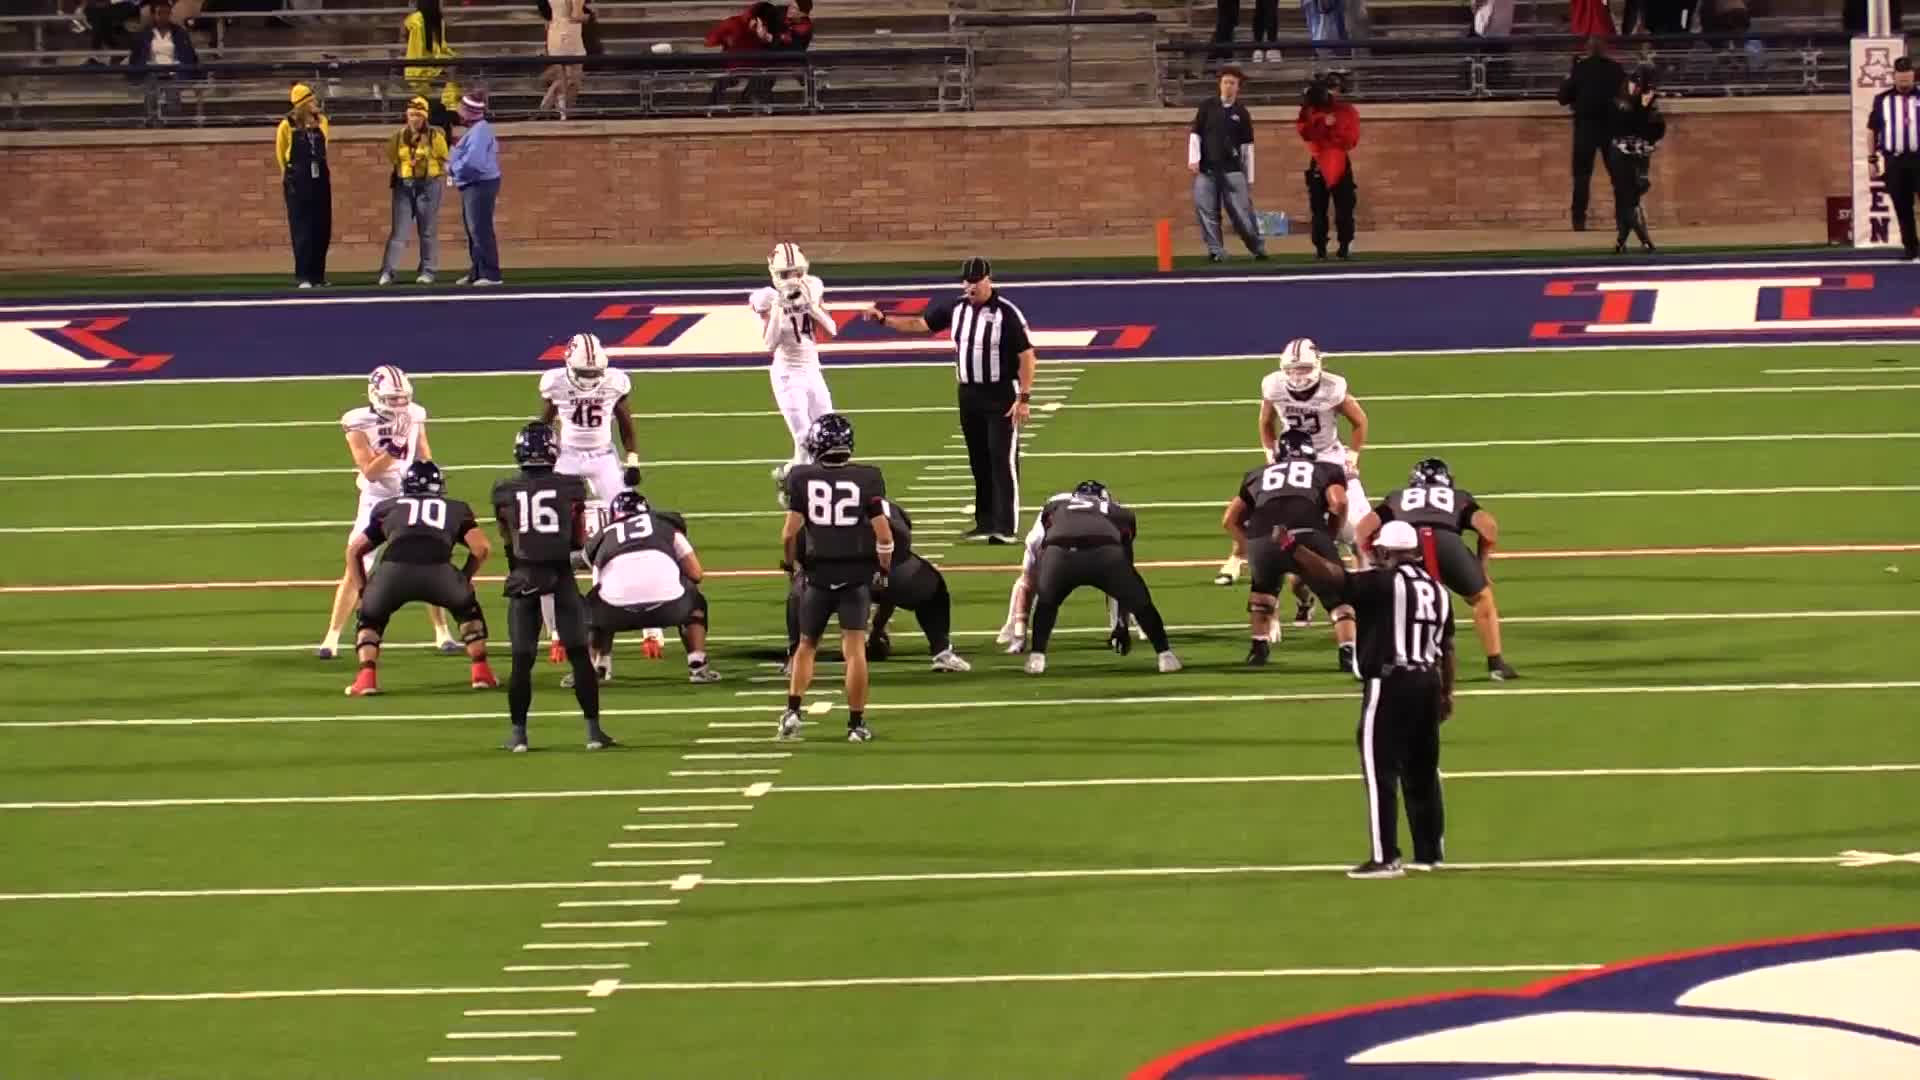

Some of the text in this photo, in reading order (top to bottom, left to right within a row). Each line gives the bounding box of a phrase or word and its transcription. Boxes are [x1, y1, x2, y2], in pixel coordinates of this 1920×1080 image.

[790, 313, 813, 344] 14
[571, 405, 602, 428] 46
[1262, 461, 1314, 490] 68
[397, 499, 447, 530] 70
[515, 490, 559, 534] 16
[807, 480, 860, 526] 82
[603, 513, 653, 544] 73
[1412, 580, 1438, 621] R
